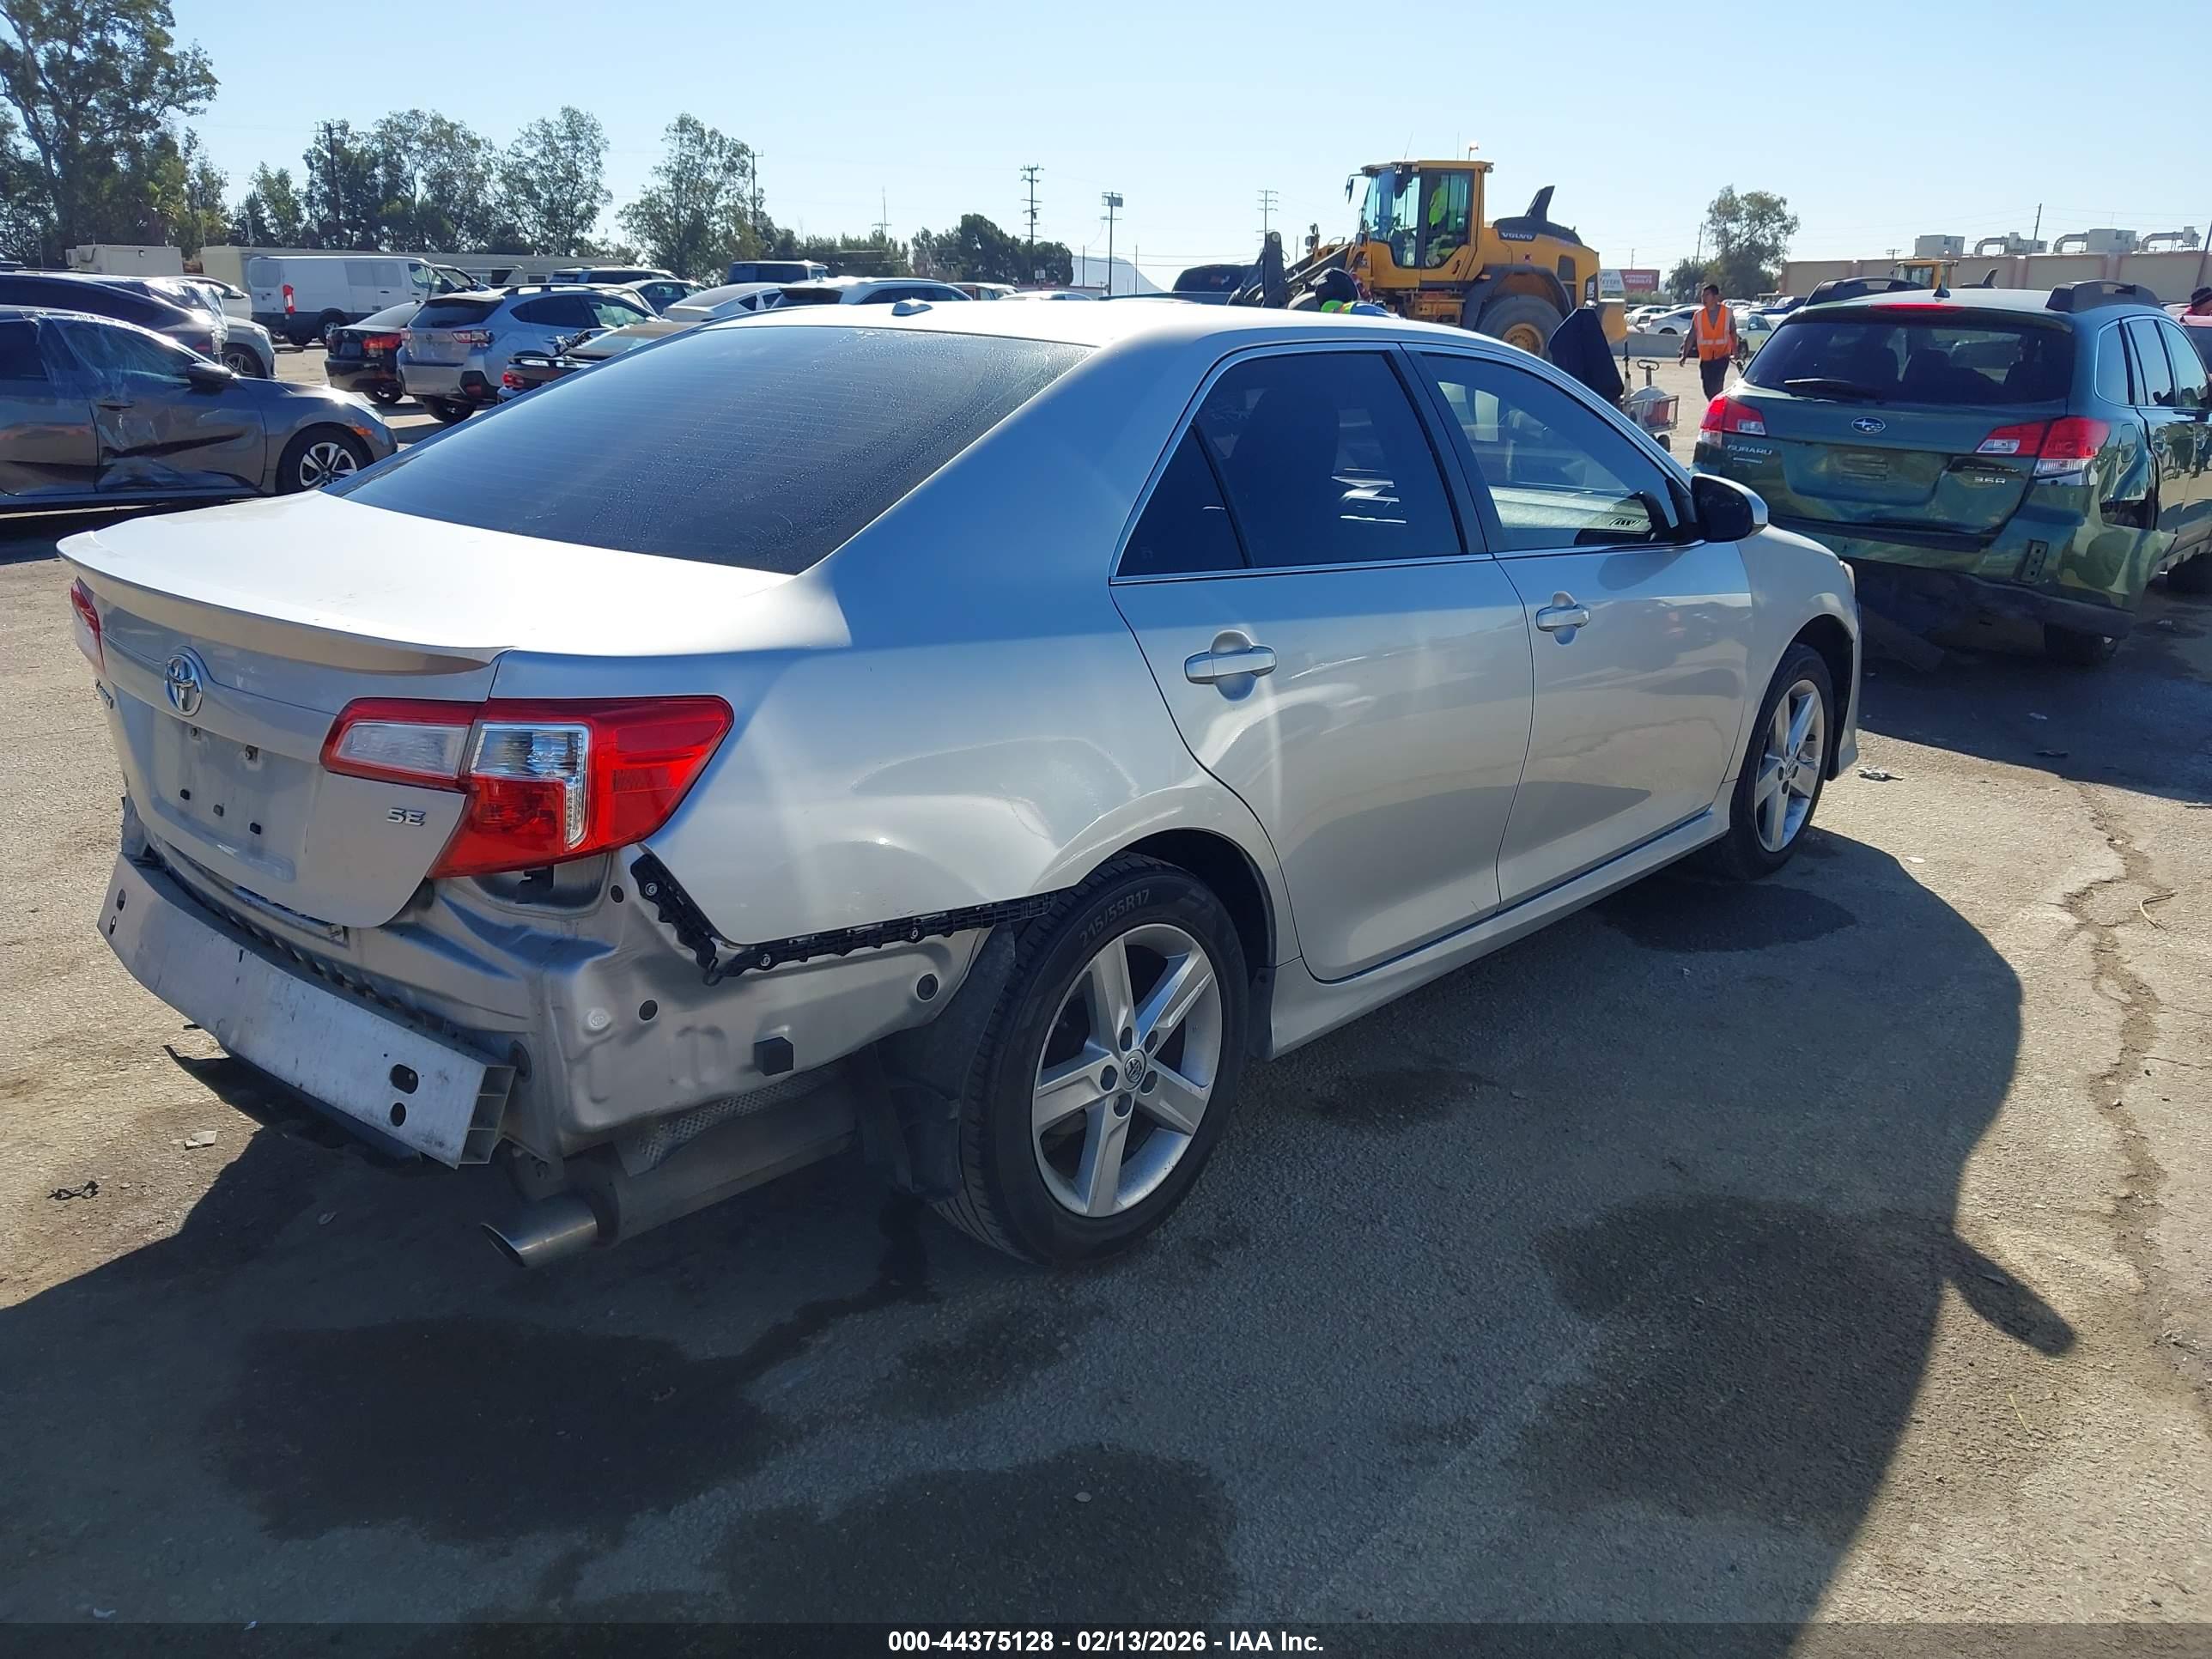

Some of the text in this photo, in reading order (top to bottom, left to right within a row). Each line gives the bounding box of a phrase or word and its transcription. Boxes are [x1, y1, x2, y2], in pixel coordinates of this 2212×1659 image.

[1727, 445, 1773, 455] SUBARU
[386, 807, 426, 827] SE
[1079, 889, 1150, 945] 215/55R17
